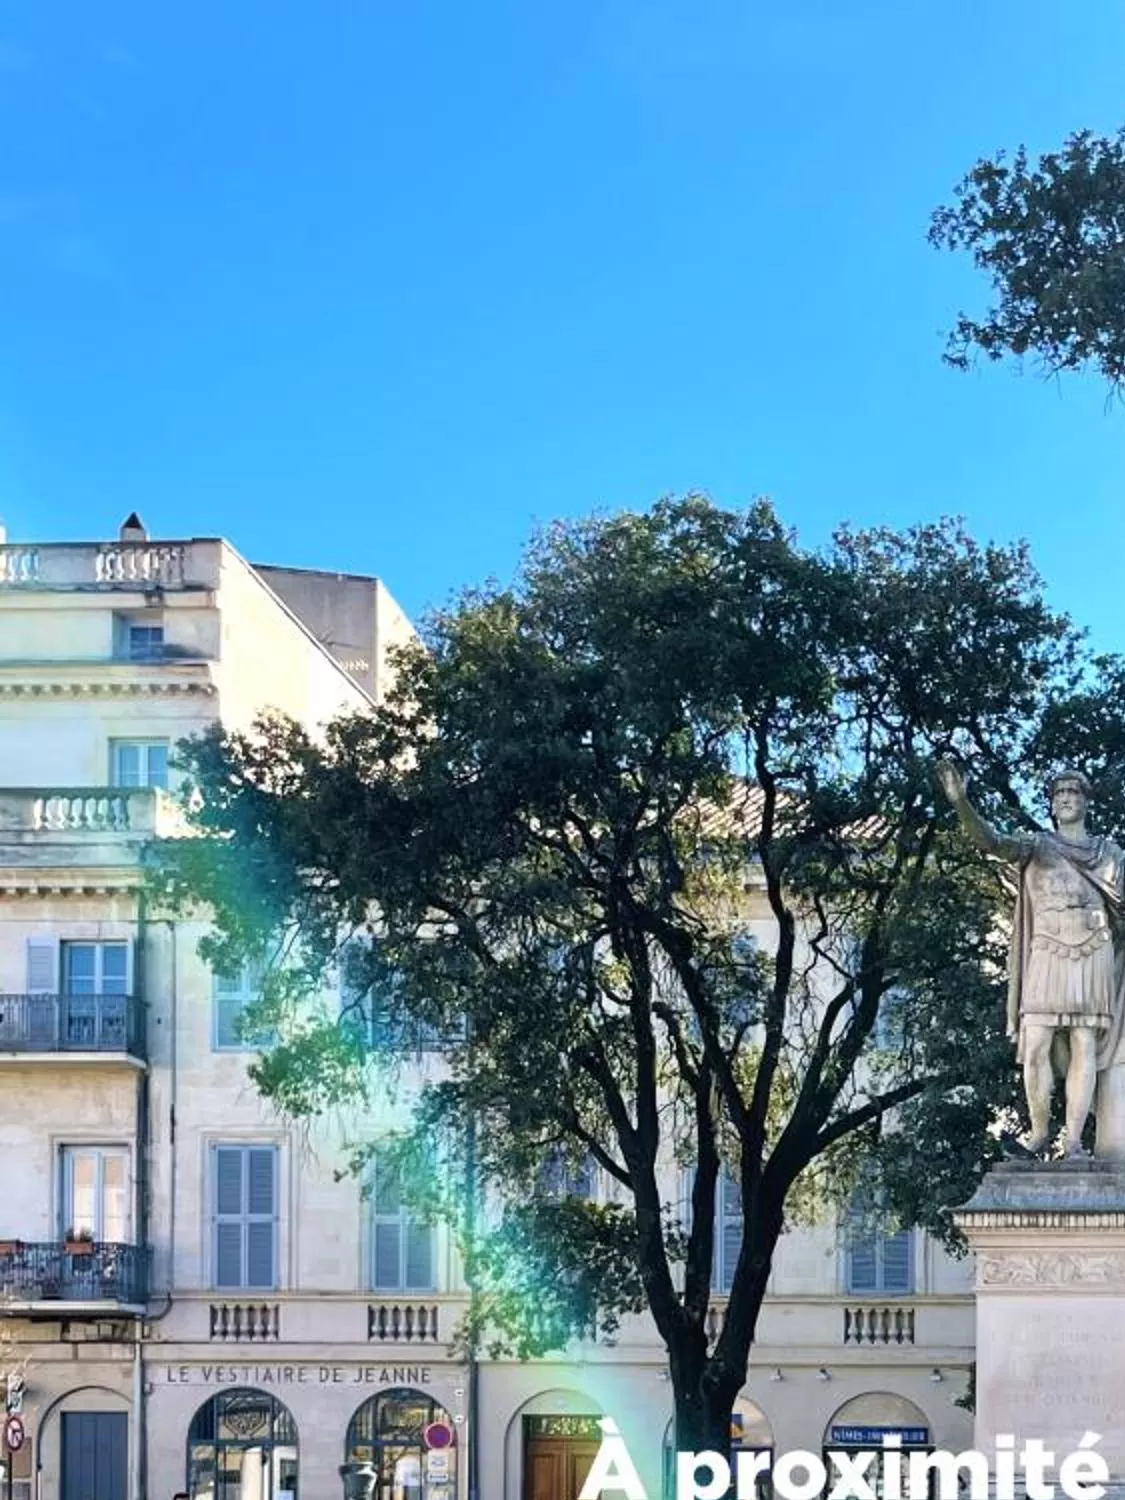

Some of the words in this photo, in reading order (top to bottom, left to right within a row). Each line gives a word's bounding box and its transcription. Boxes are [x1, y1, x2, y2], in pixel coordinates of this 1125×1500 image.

[166, 1365, 189, 1382] LE
[201, 1365, 306, 1383] VESTIAIRE
[319, 1366, 344, 1383] DE
[353, 1366, 431, 1383] JEANNE
